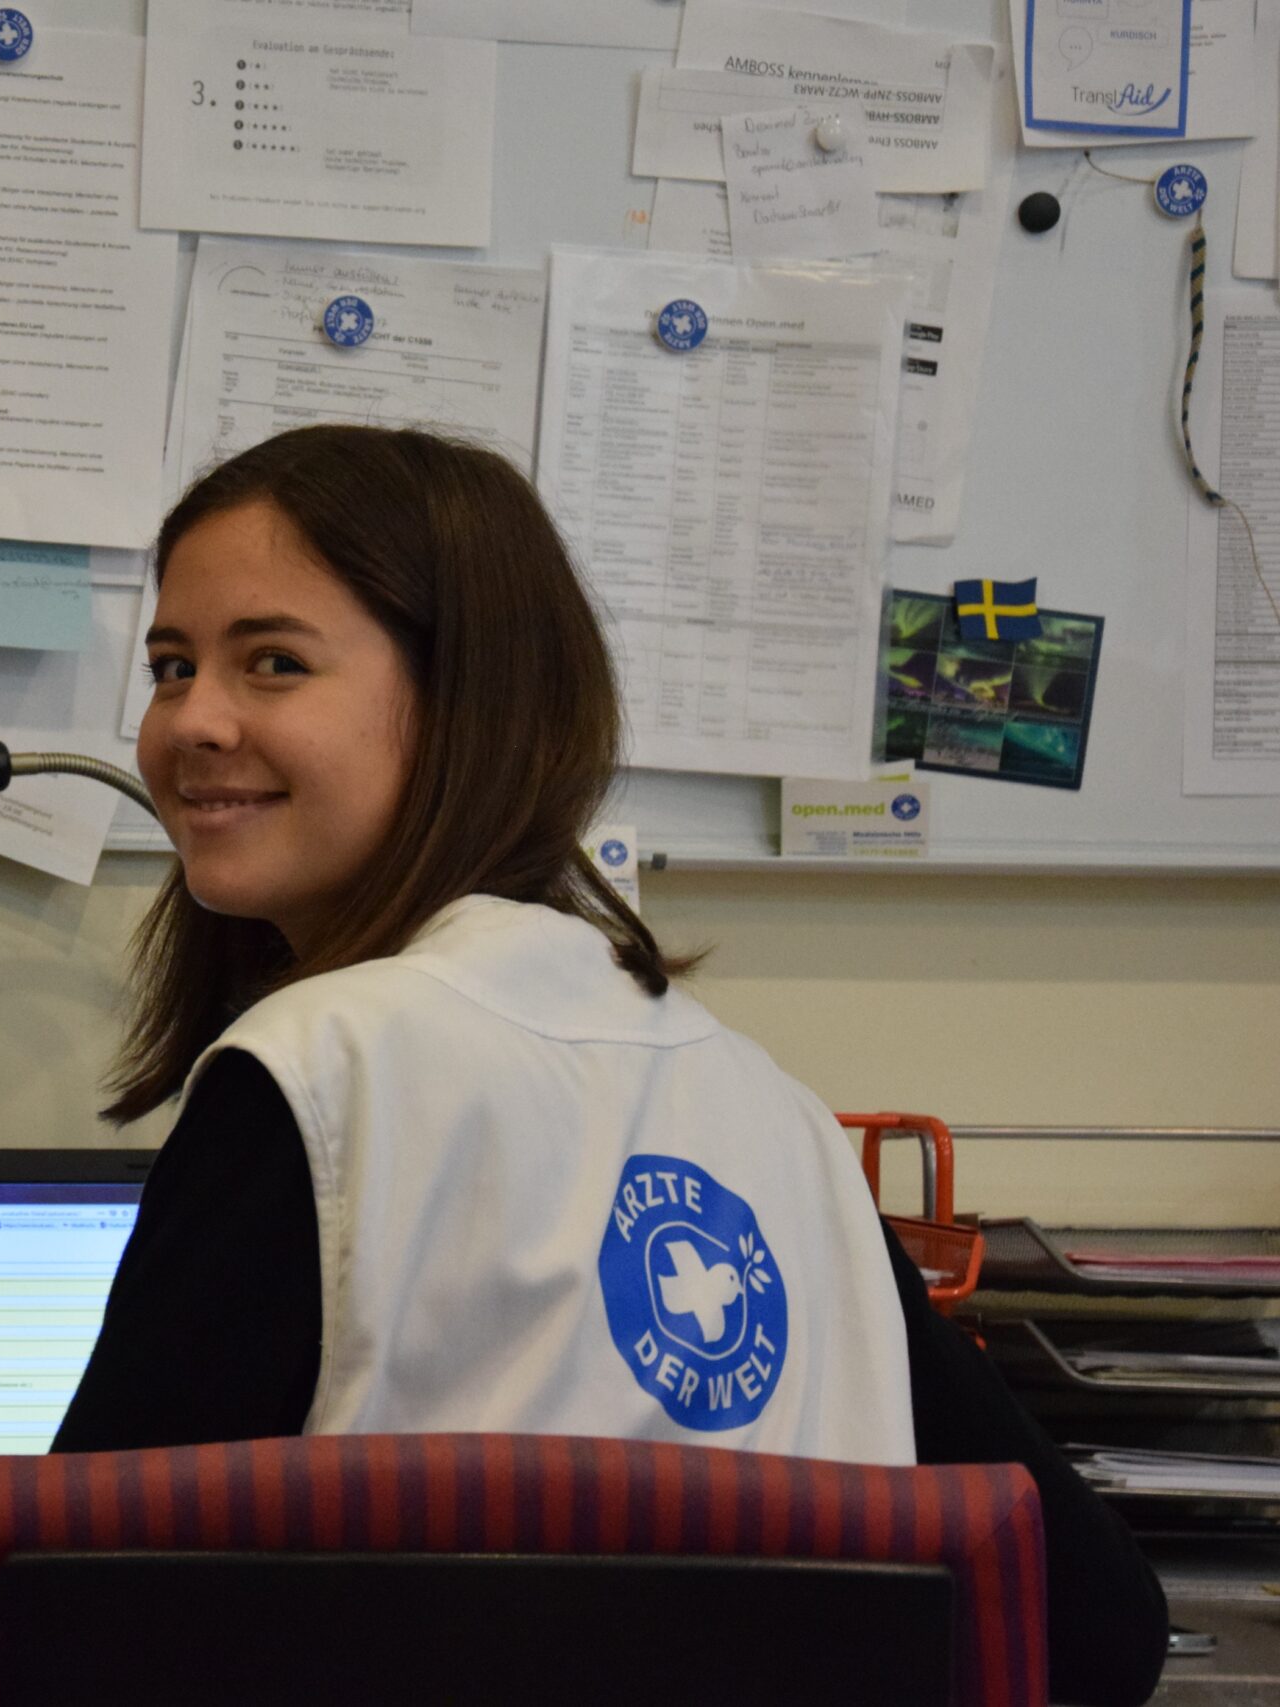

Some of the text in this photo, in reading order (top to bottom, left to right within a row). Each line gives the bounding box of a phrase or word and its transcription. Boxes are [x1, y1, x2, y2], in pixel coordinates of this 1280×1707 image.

[252, 40, 304, 53] Evaluation
[724, 55, 785, 78] AMBOSS
[191, 80, 217, 107] 3.
[893, 137, 938, 150] AMBOSS
[791, 802, 886, 817] open.med
[612, 1171, 776, 1412] ÄRZTE DER WELT
